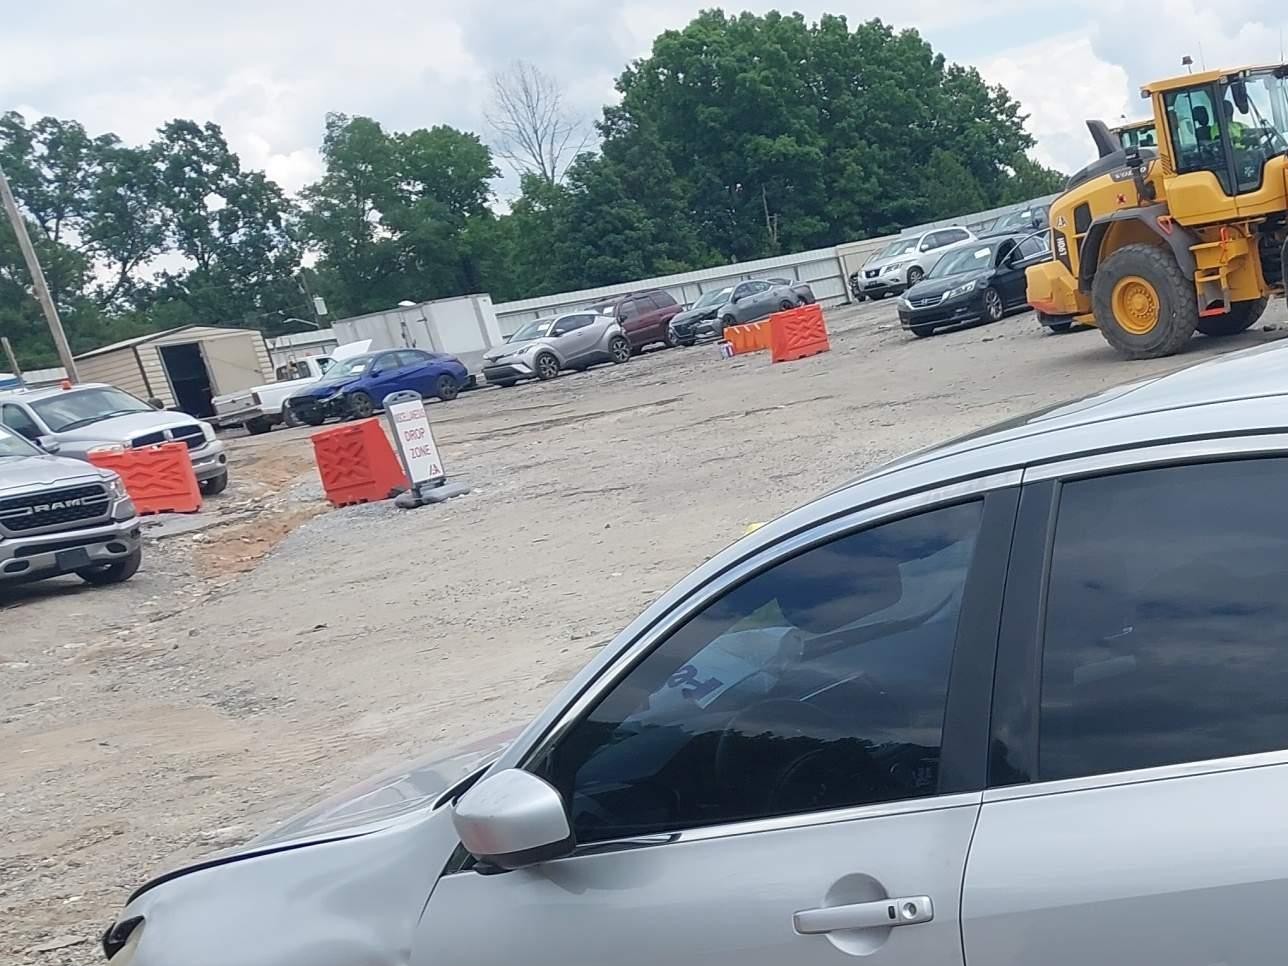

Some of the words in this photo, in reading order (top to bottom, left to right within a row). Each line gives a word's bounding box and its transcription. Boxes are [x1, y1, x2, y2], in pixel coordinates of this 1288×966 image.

[403, 427, 425, 442] DROP
[409, 444, 431, 459] ZONE
[34, 499, 80, 513] RAM
